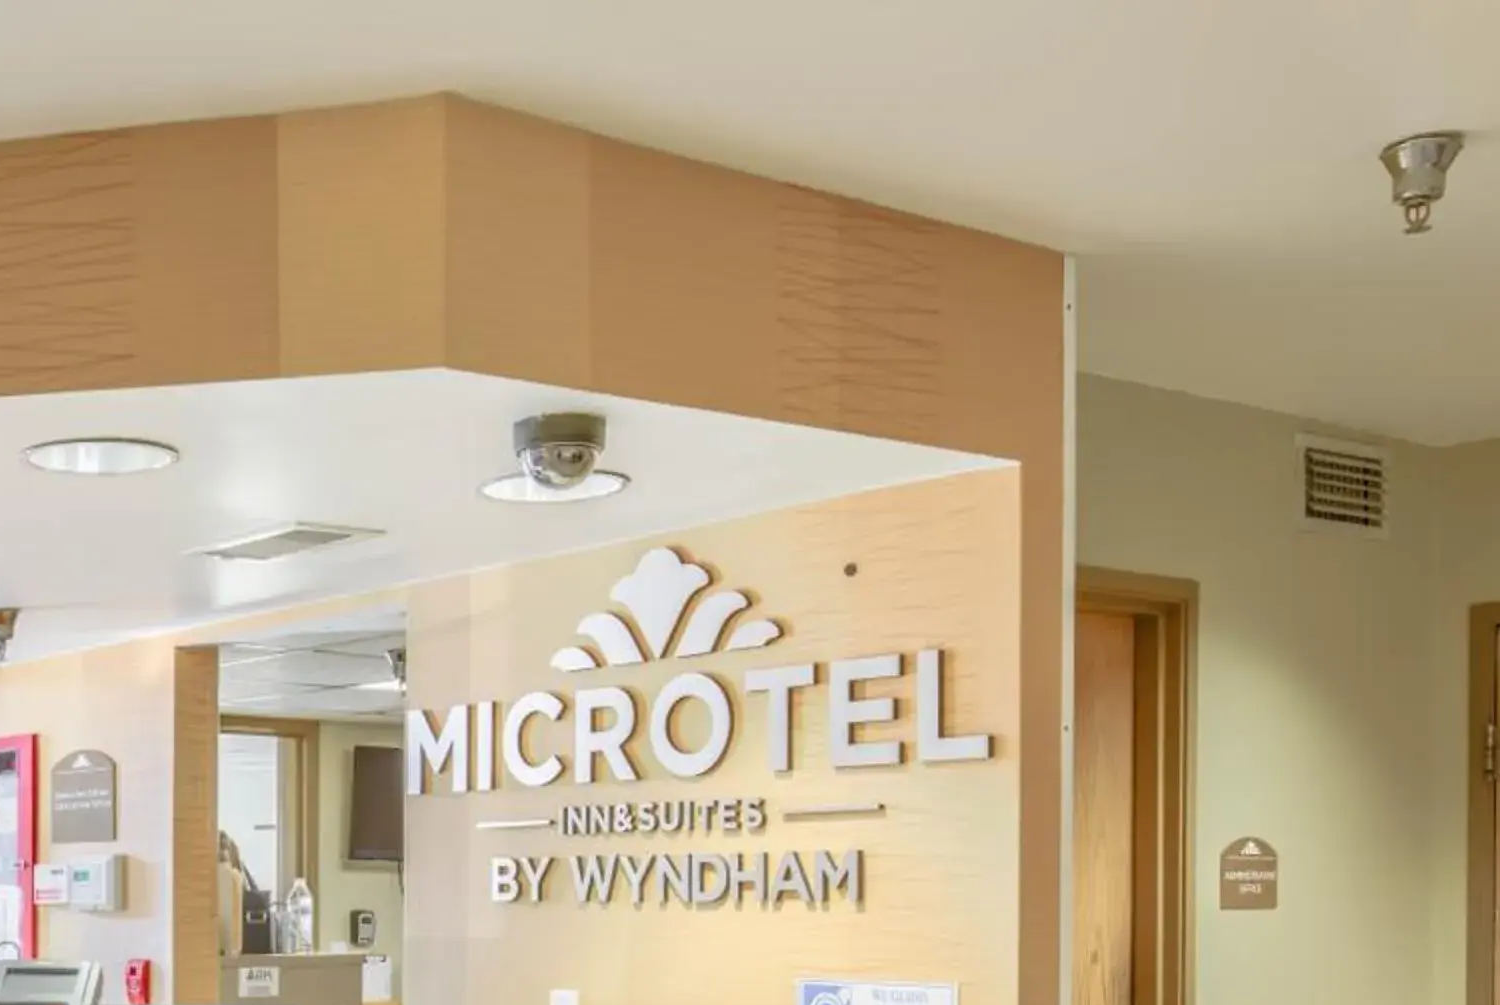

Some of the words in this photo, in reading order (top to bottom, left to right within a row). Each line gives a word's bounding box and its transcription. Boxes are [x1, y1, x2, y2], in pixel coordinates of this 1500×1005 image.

[406, 648, 993, 795] MICROTEL
[490, 854, 554, 903] BY
[569, 849, 864, 908] WYNDHAM
